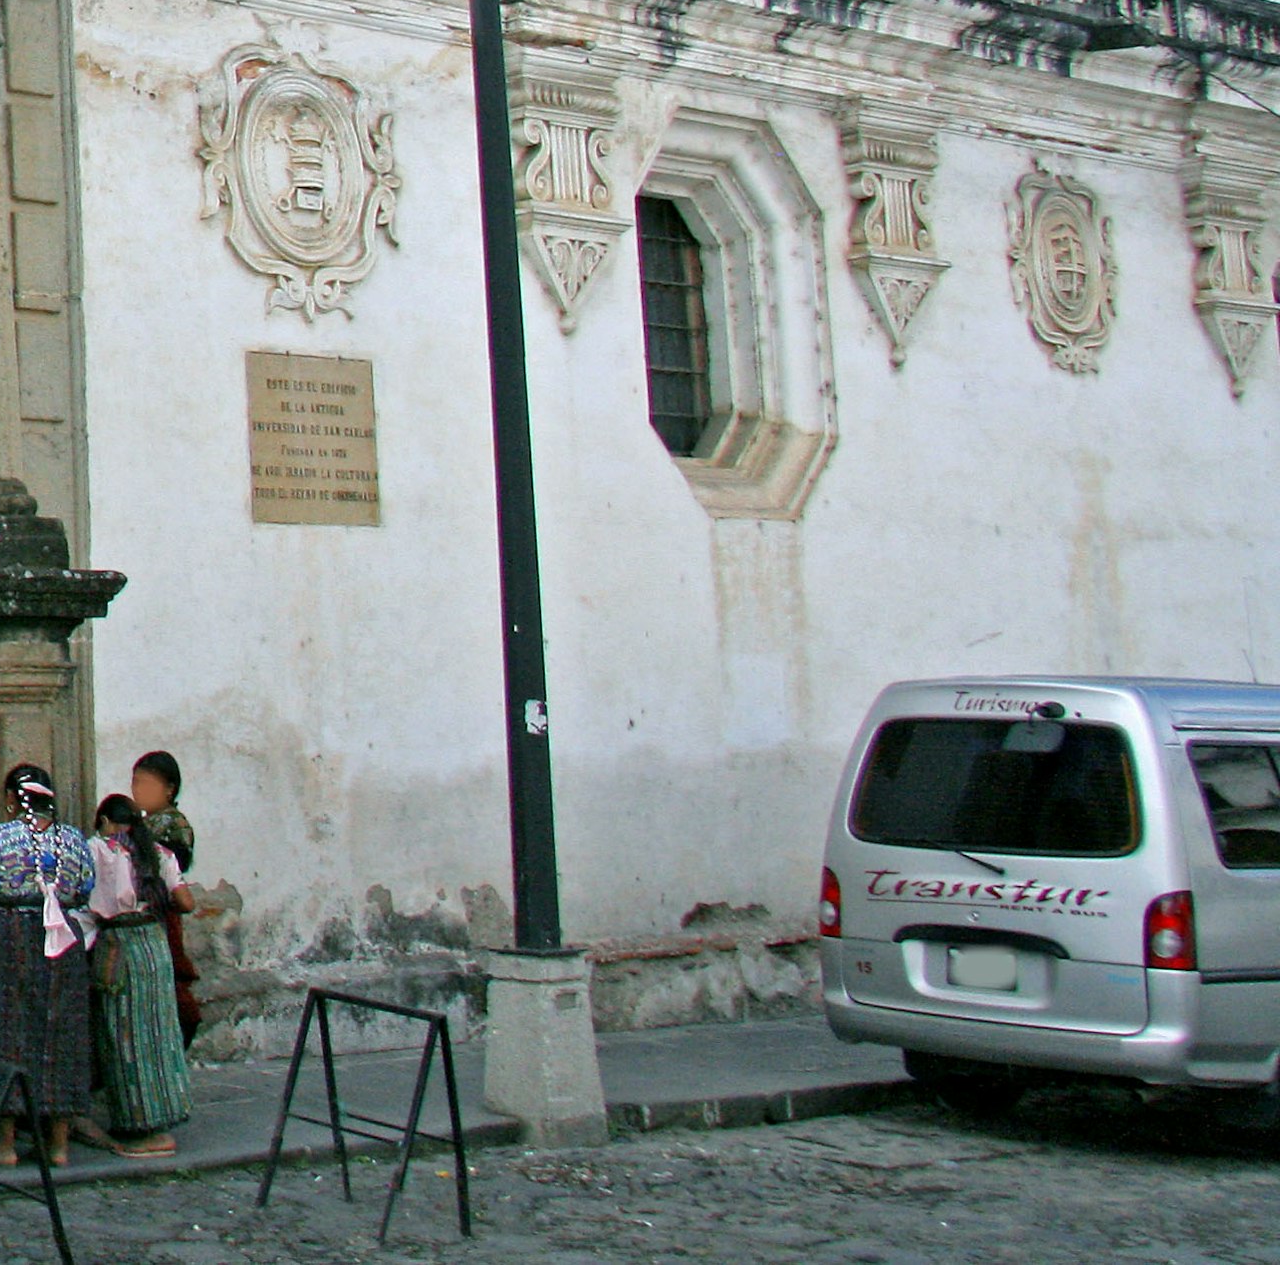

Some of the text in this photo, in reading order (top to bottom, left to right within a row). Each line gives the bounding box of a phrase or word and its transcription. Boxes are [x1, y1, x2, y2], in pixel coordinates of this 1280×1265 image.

[267, 378, 289, 390] ESTE
[293, 381, 303, 391] ES
[307, 381, 318, 392] EL
[281, 401, 291, 412] DE
[295, 403, 305, 413] LA
[252, 421, 306, 433] UNIVERSIDAD
[310, 425, 320, 435] DE
[324, 426, 340, 436] SAN
[321, 469, 331, 479] LA
[335, 470, 370, 481] CULTURA
[320, 490, 329, 500] DE
[865, 869, 1110, 906] Transtur
[999, 903, 1045, 912] RENT
[1070, 909, 1108, 918] BUS
[856, 960, 873, 974] 15
